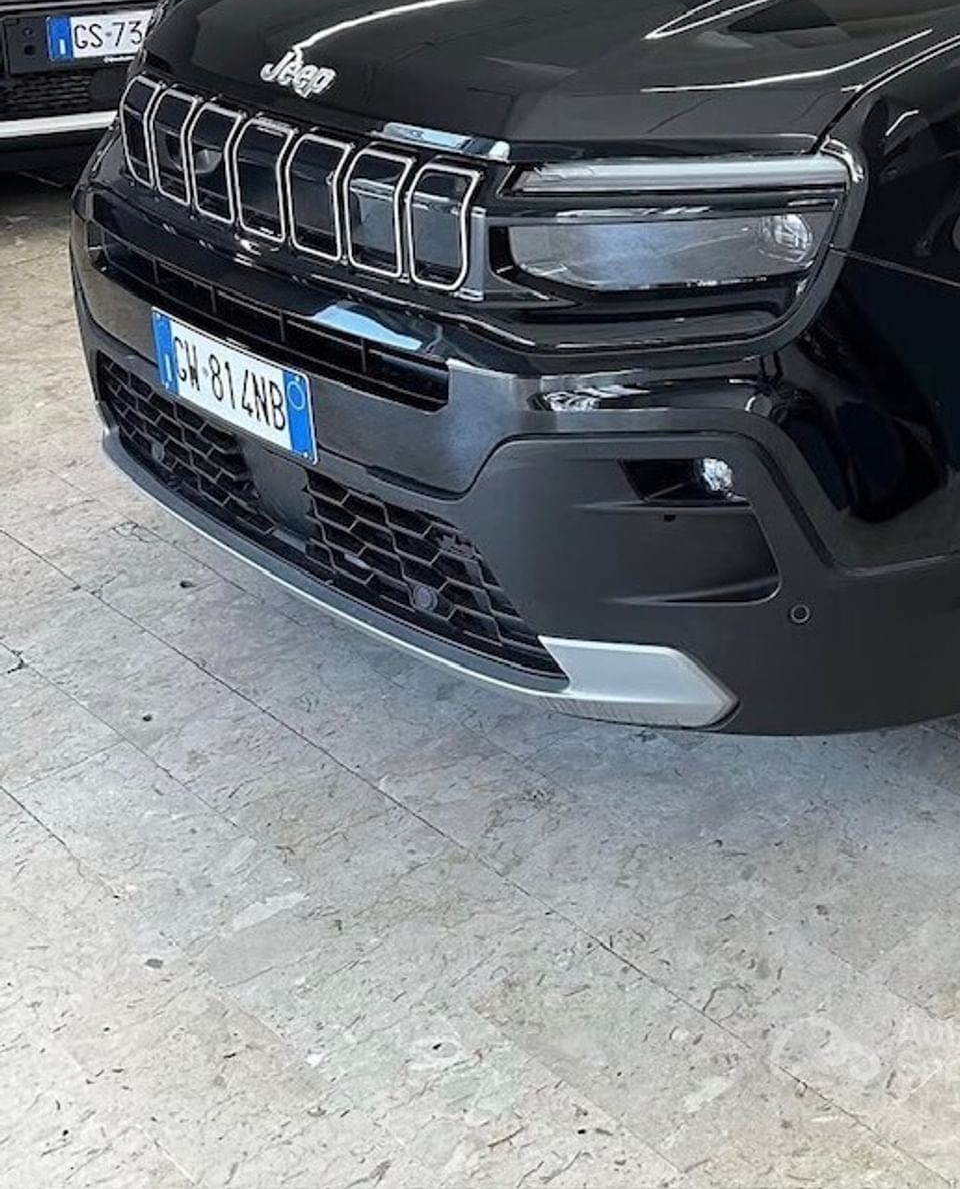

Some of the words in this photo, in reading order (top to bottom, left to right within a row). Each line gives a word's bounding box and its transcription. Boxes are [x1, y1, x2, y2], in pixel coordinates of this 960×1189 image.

[73, 23, 104, 50] GS
[111, 19, 143, 48] 73
[260, 50, 337, 99] Jeep
[208, 353, 287, 432] 814NB
